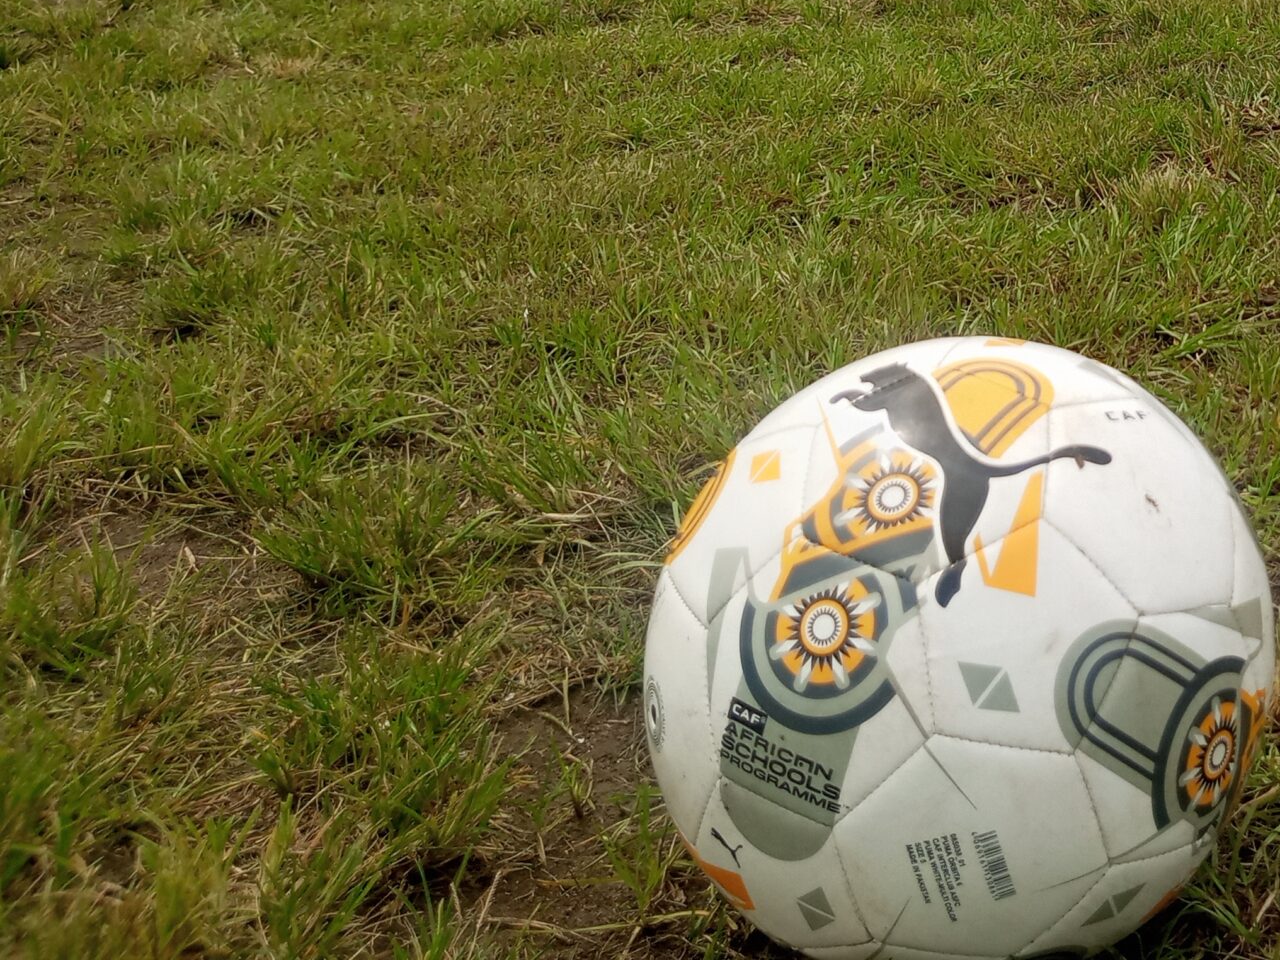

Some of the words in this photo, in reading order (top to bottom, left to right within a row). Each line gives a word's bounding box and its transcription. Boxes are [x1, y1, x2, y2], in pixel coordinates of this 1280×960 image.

[1105, 410, 1146, 421] CAF
[721, 735, 840, 800] SCHOOLS
[725, 722, 833, 780] AFRICAN
[905, 844, 918, 864] MADE
[915, 874, 931, 904] PAKISTAN
[915, 842, 925, 858] SIZE
[932, 838, 942, 852] CAF
[937, 854, 954, 890] INTERCLUB
[941, 835, 952, 857] PUMA
[948, 857, 960, 882] ORBITA
[923, 840, 934, 861] PUMA
[945, 902, 957, 922] COLOR
